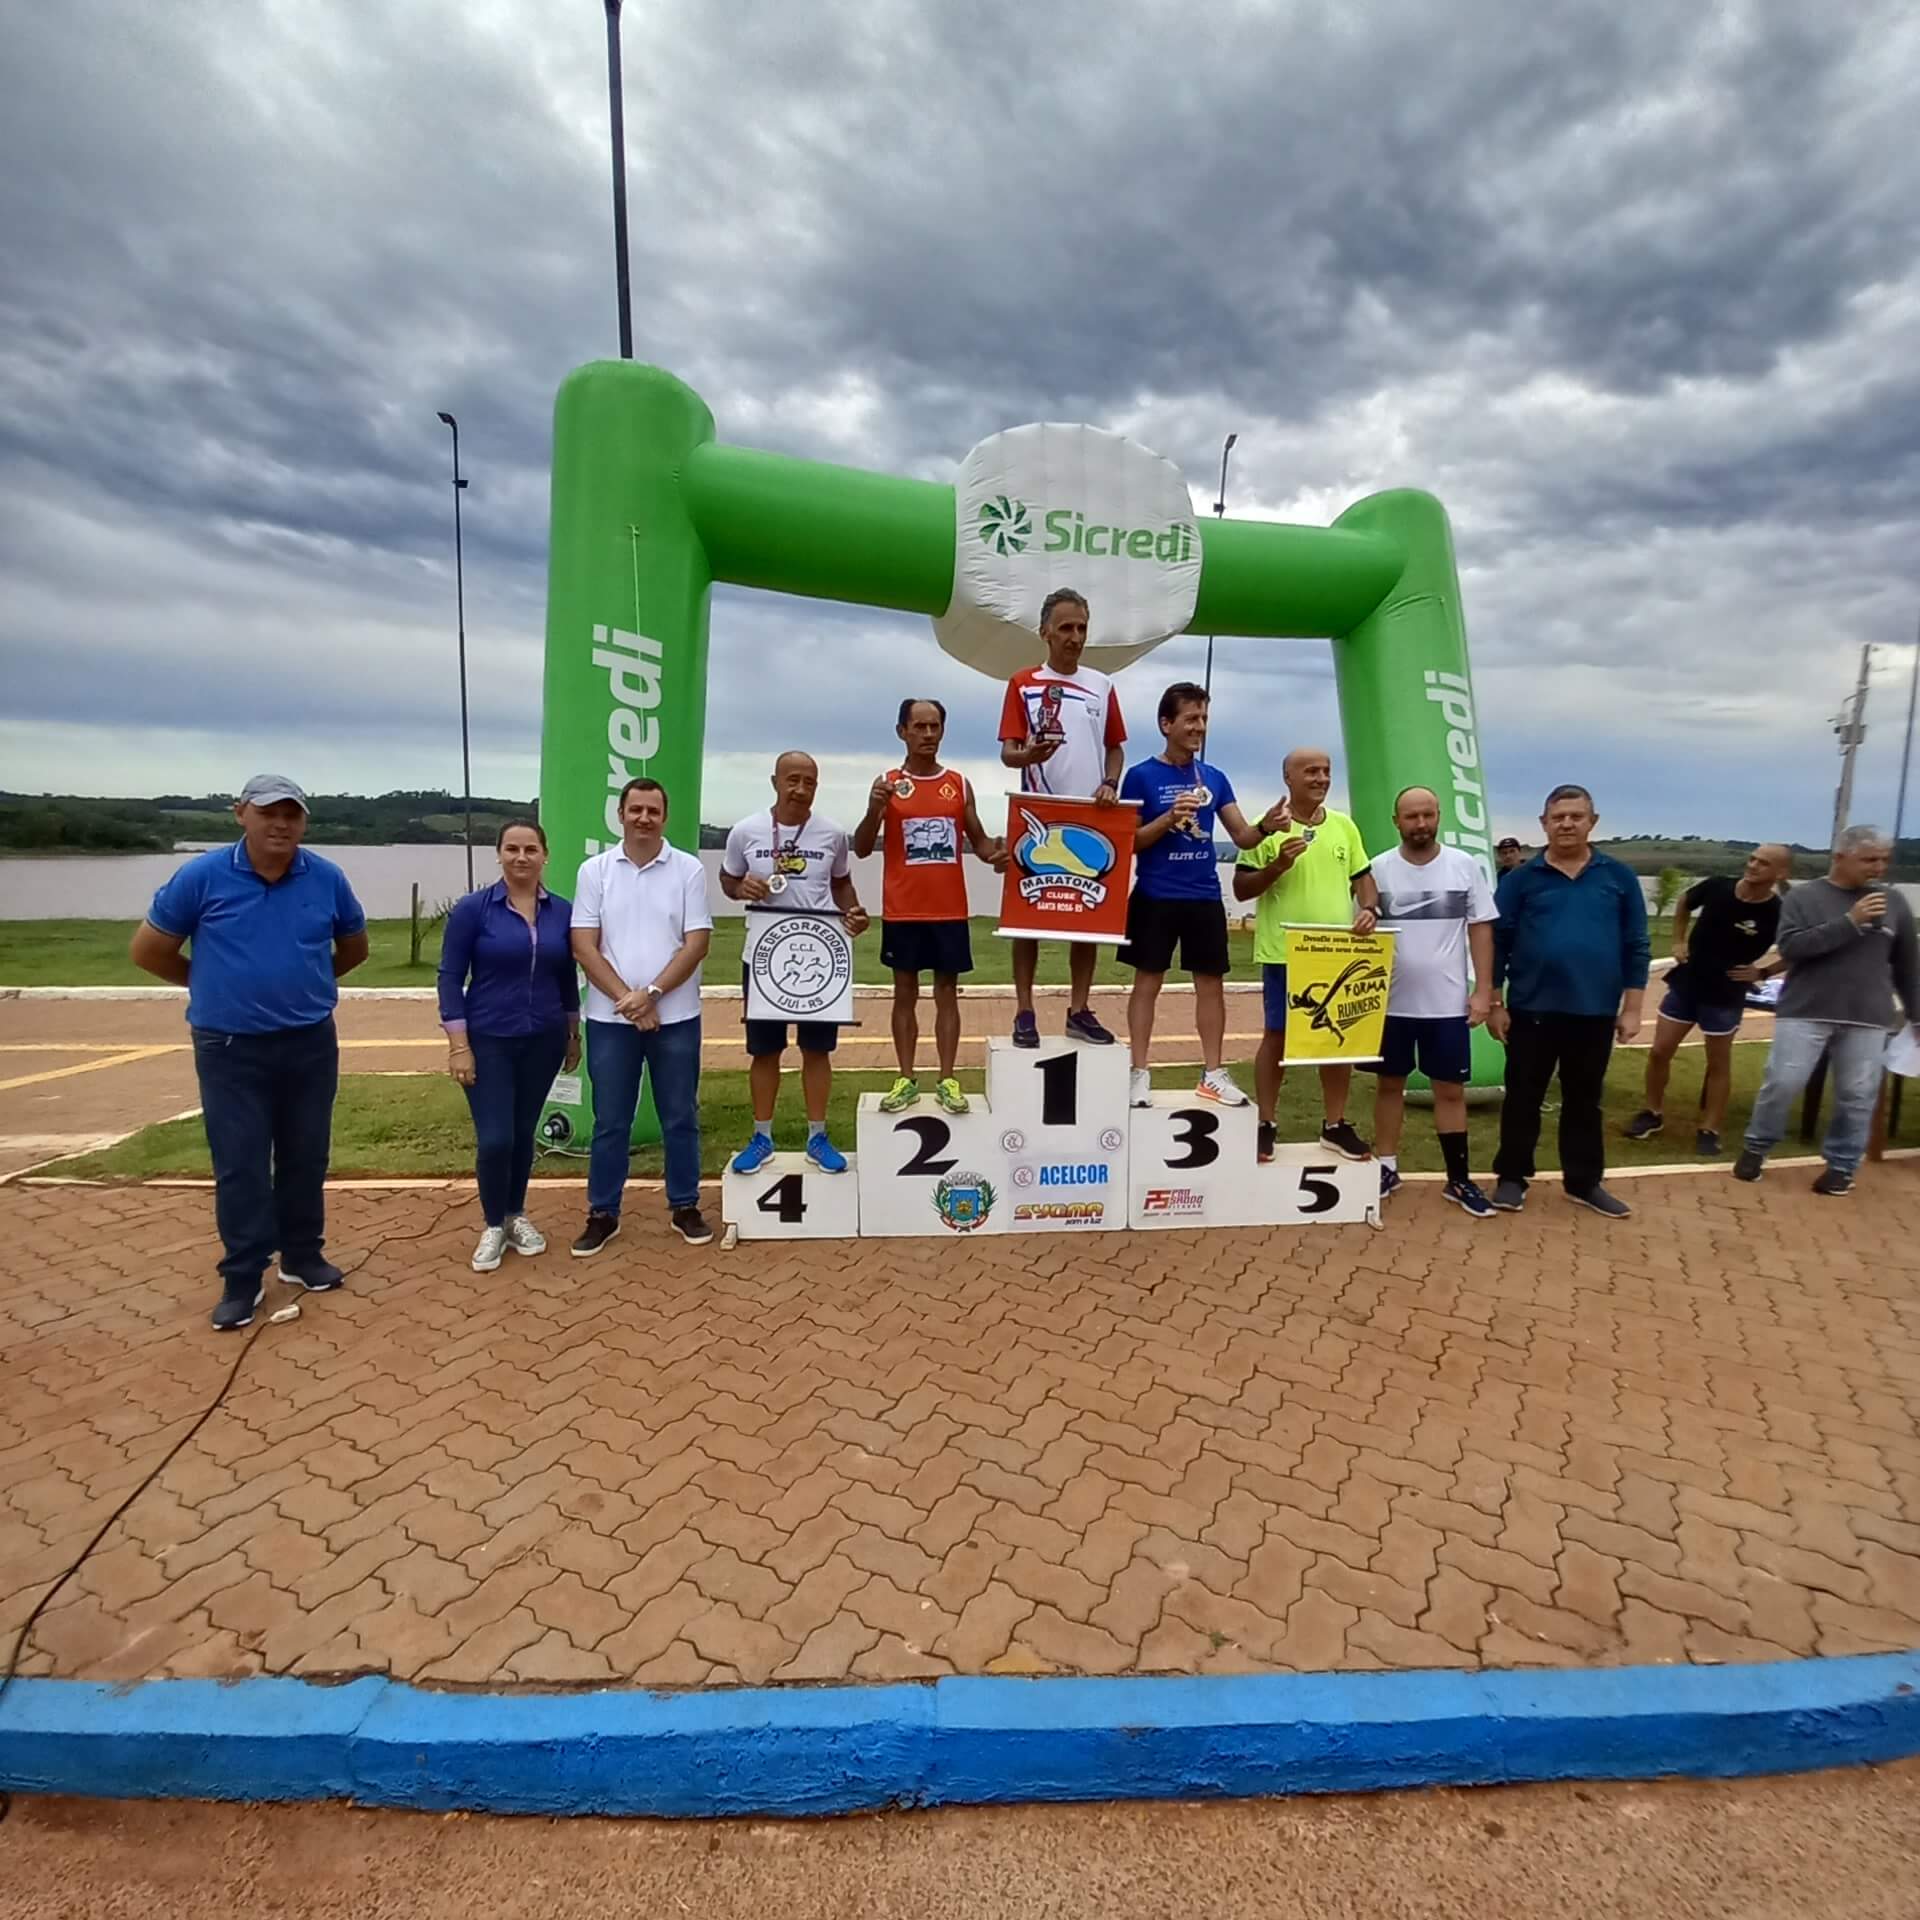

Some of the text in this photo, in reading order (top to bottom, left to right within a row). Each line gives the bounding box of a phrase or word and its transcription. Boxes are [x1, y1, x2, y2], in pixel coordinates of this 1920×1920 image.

[1044, 510, 1192, 563] Sicredi
[1022, 876, 1100, 894] MARATONA
[1046, 891, 1076, 900] CLUBE
[756, 921, 848, 979] CLUBE DE CORREDORES DE
[808, 997, 824, 1009] RS
[1337, 995, 1381, 1018] RUNNERS
[1344, 979, 1387, 998] FORMA
[1034, 1051, 1078, 1126] 1
[893, 1116, 959, 1176] 2
[1164, 1109, 1220, 1169] 3
[756, 1174, 808, 1223] 4
[1040, 1164, 1108, 1185] ACELCOR
[1297, 1165, 1340, 1214] 5
